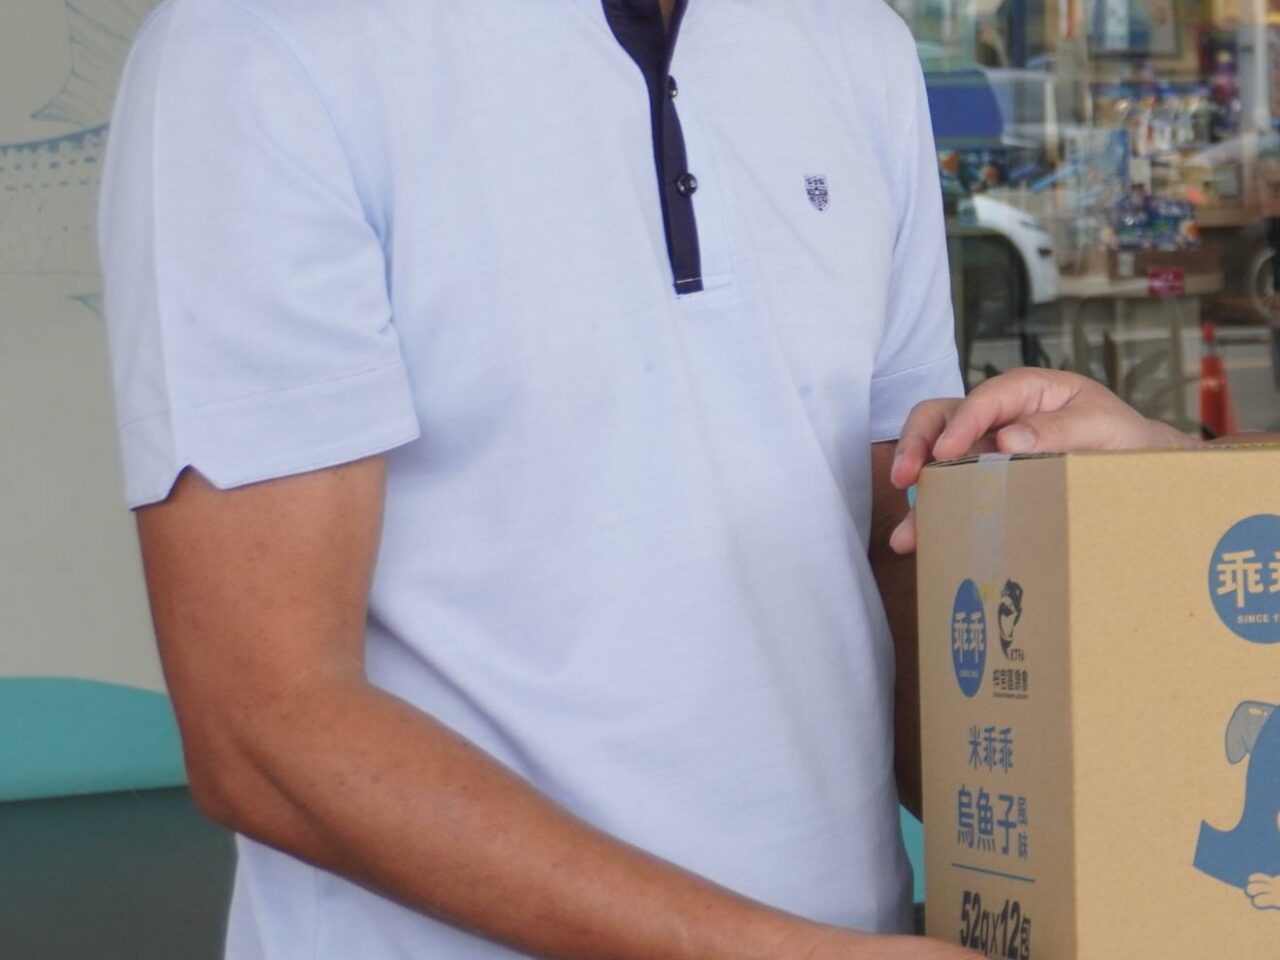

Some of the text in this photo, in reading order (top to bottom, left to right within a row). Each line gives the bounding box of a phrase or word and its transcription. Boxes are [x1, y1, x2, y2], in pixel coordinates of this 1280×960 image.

[1237, 614, 1270, 624] SINCE
[969, 725, 1014, 774] 米乖乖
